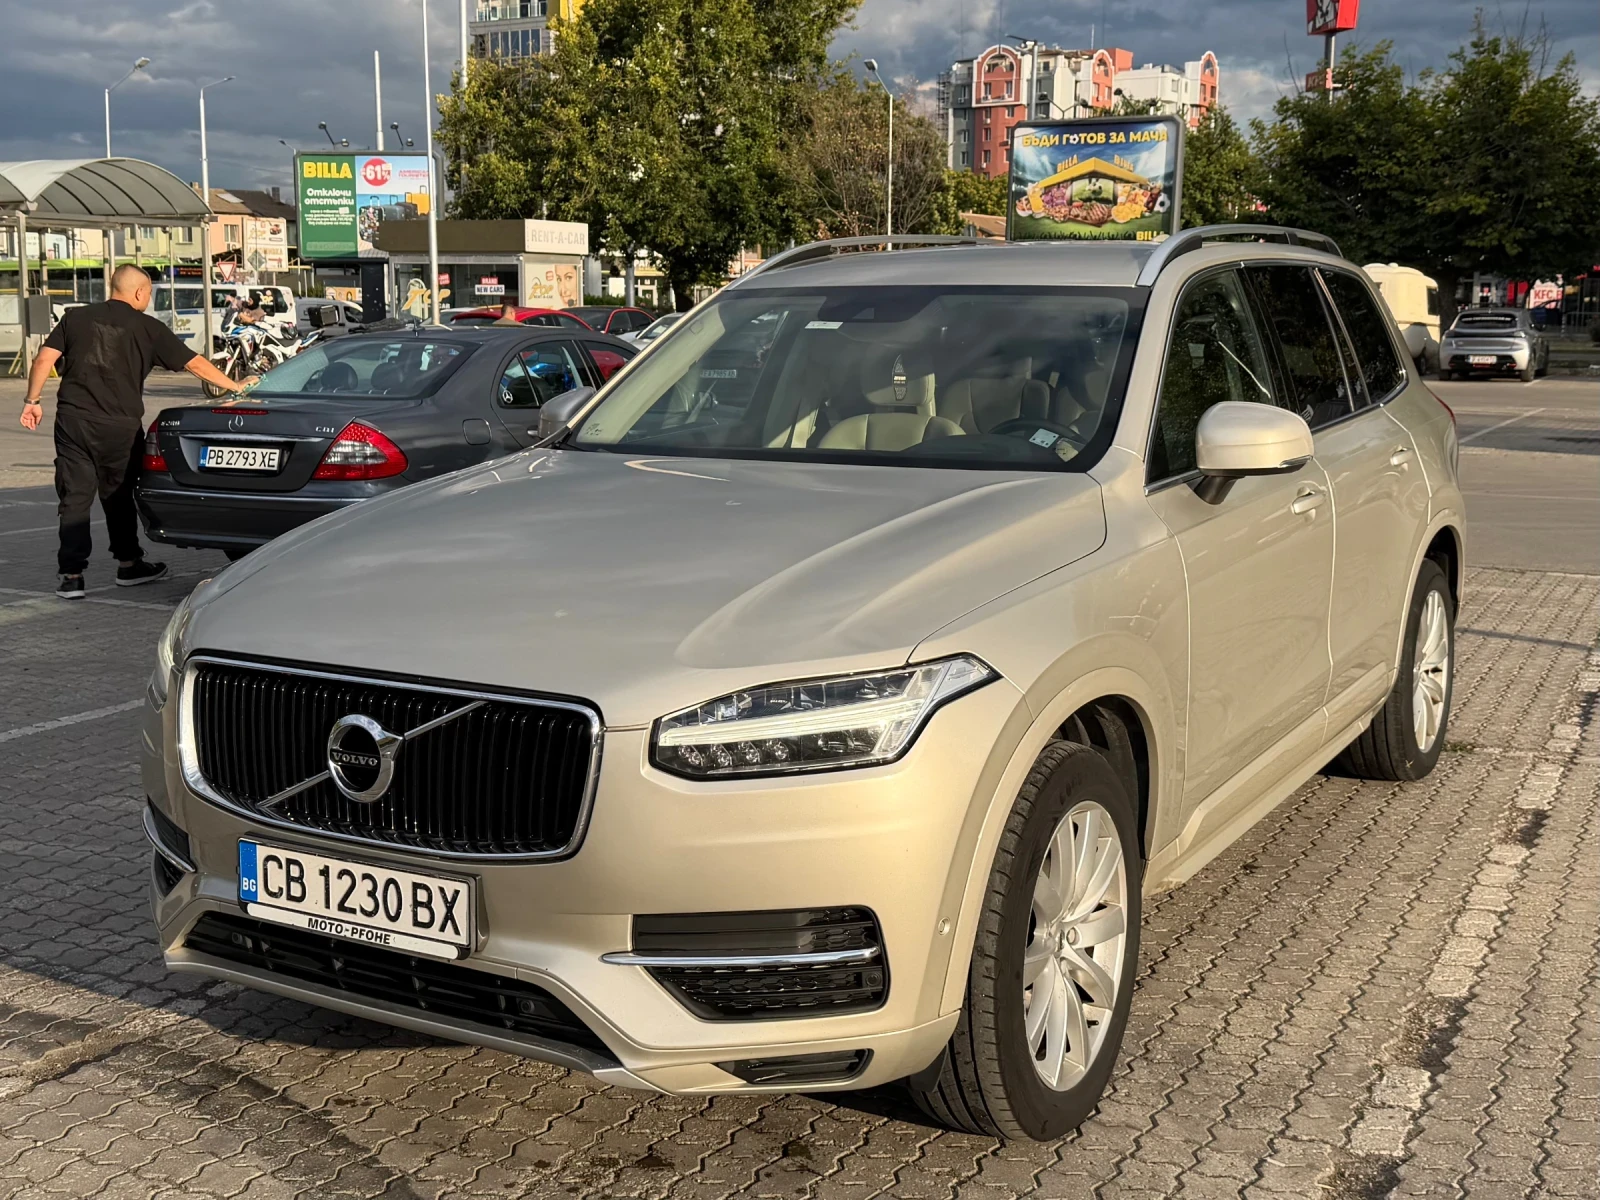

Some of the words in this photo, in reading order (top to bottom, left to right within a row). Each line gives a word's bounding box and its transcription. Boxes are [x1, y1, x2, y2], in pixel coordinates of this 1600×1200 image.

[1022, 134, 1059, 147] БЪДИ
[1062, 133, 1106, 145] ГОТОВ
[1109, 132, 1126, 144] ЗА
[1129, 131, 1168, 143] МАЧА
[303, 162, 353, 179] BILLA
[306, 187, 352, 197] Отключи
[304, 196, 355, 206] отстъпки
[531, 228, 586, 246] RENT-A-CAR
[1534, 289, 1553, 300] KFC
[315, 426, 335, 434] CDI
[207, 449, 224, 465] PB
[226, 450, 257, 467] 2793
[259, 451, 278, 468] XE
[331, 751, 379, 768] VOLVO
[242, 877, 257, 893] BG
[262, 854, 307, 903] CB
[318, 864, 404, 924] 1230
[411, 881, 462, 937] BX
